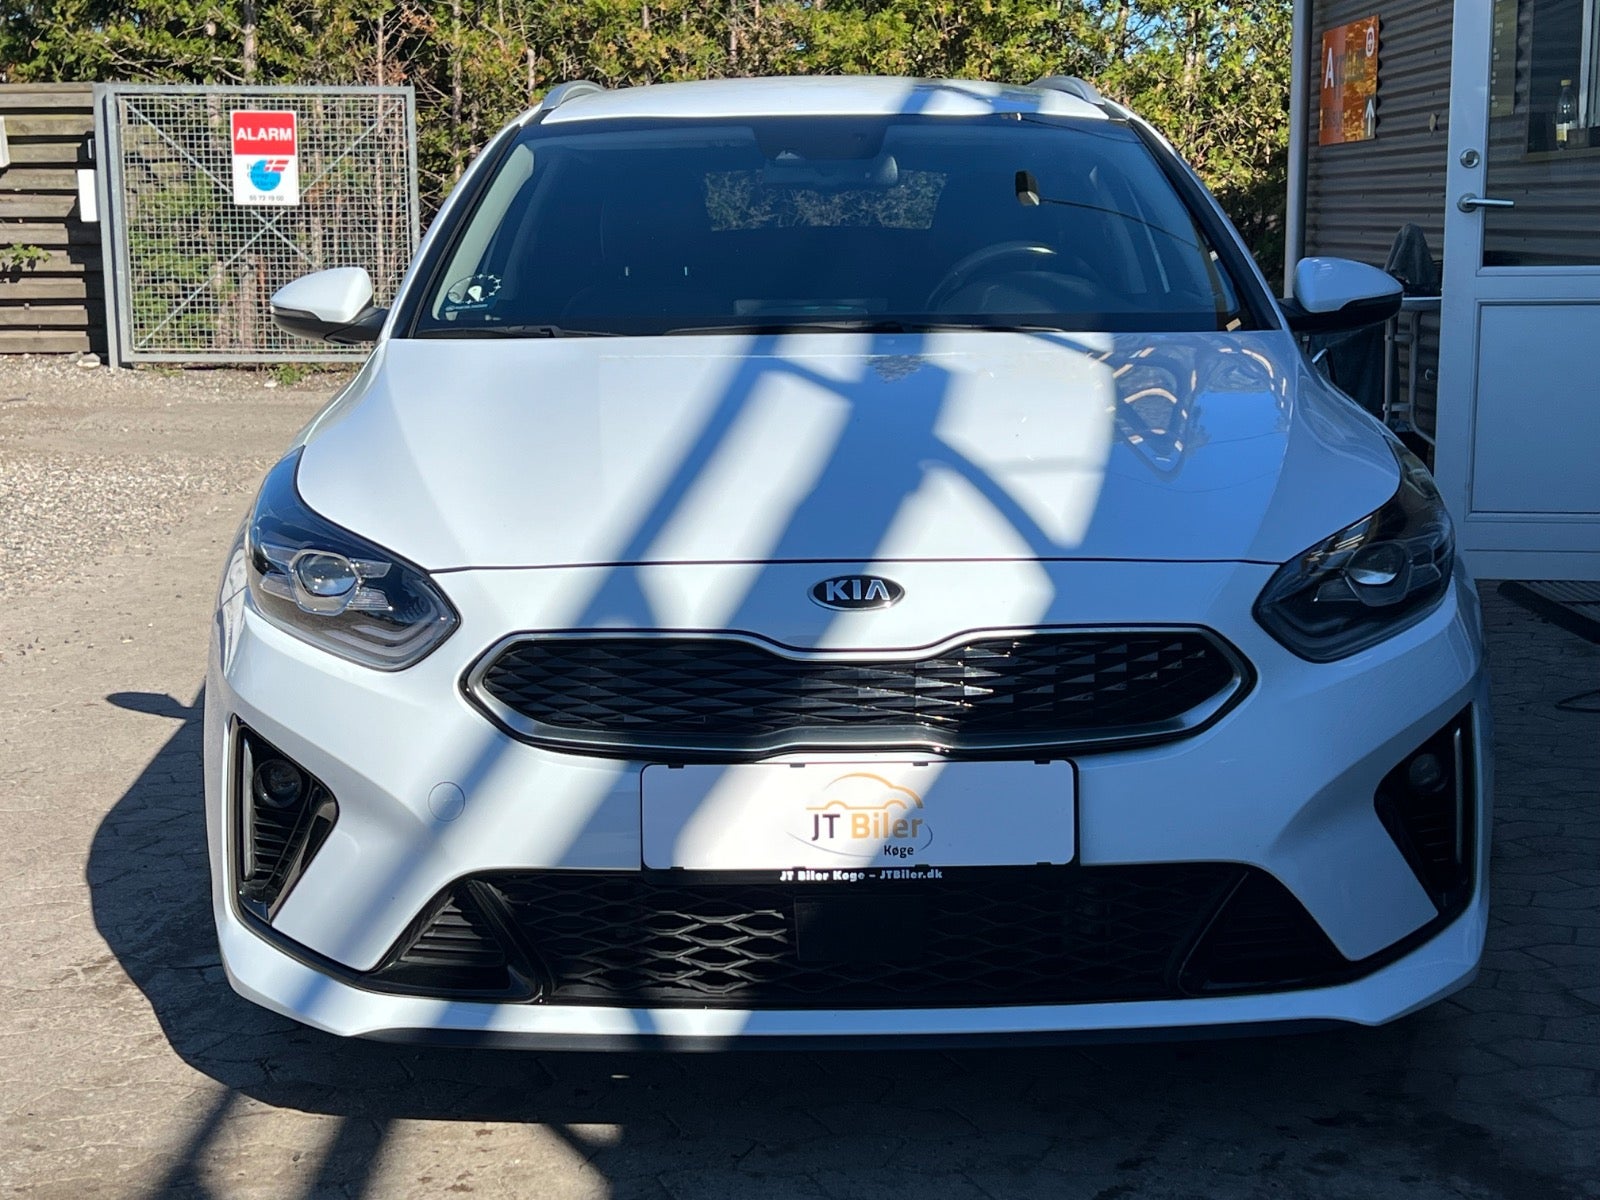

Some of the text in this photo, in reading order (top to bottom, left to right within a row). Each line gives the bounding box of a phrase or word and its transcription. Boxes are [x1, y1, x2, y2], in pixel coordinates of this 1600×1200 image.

[236, 127, 292, 141] ALARM
[825, 579, 890, 601] KIA
[811, 812, 923, 841] JT Biler
[884, 845, 914, 858] Køge
[780, 871, 794, 881] JT
[798, 870, 828, 881] Biler
[880, 869, 942, 879] JTBiler.dk
